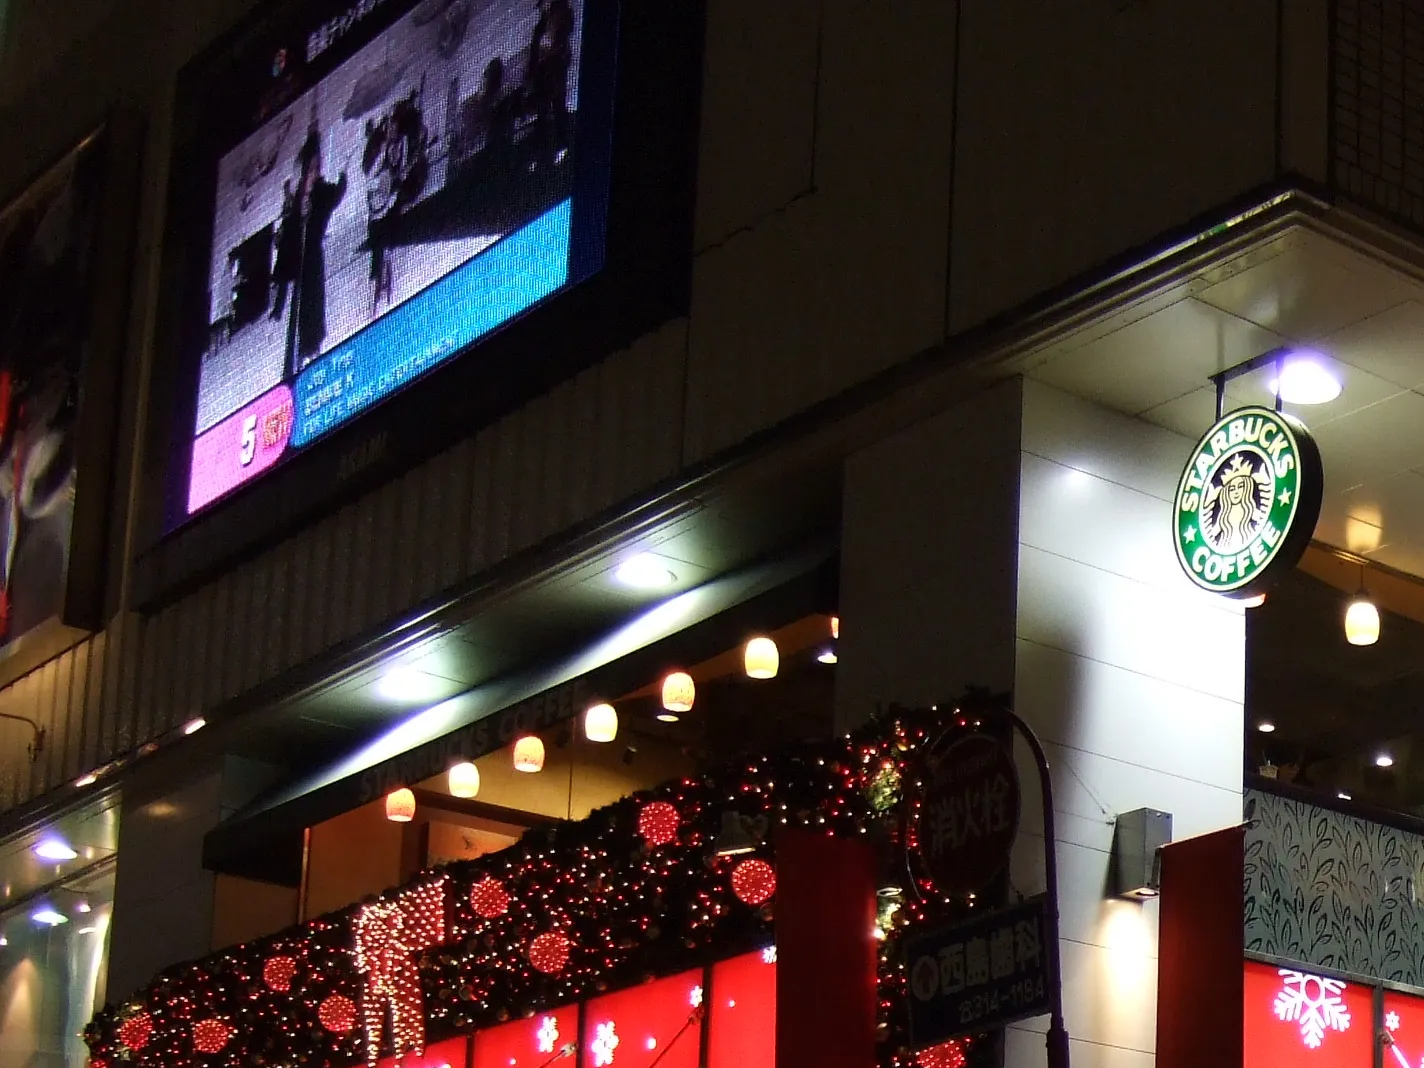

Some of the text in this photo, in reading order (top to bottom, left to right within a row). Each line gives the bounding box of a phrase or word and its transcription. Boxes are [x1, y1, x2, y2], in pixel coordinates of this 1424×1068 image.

[240, 414, 257, 468] 5
[1181, 416, 1295, 512] STARBUCKS
[1191, 524, 1282, 583] COFFEE
[929, 772, 1011, 854] 消火栓
